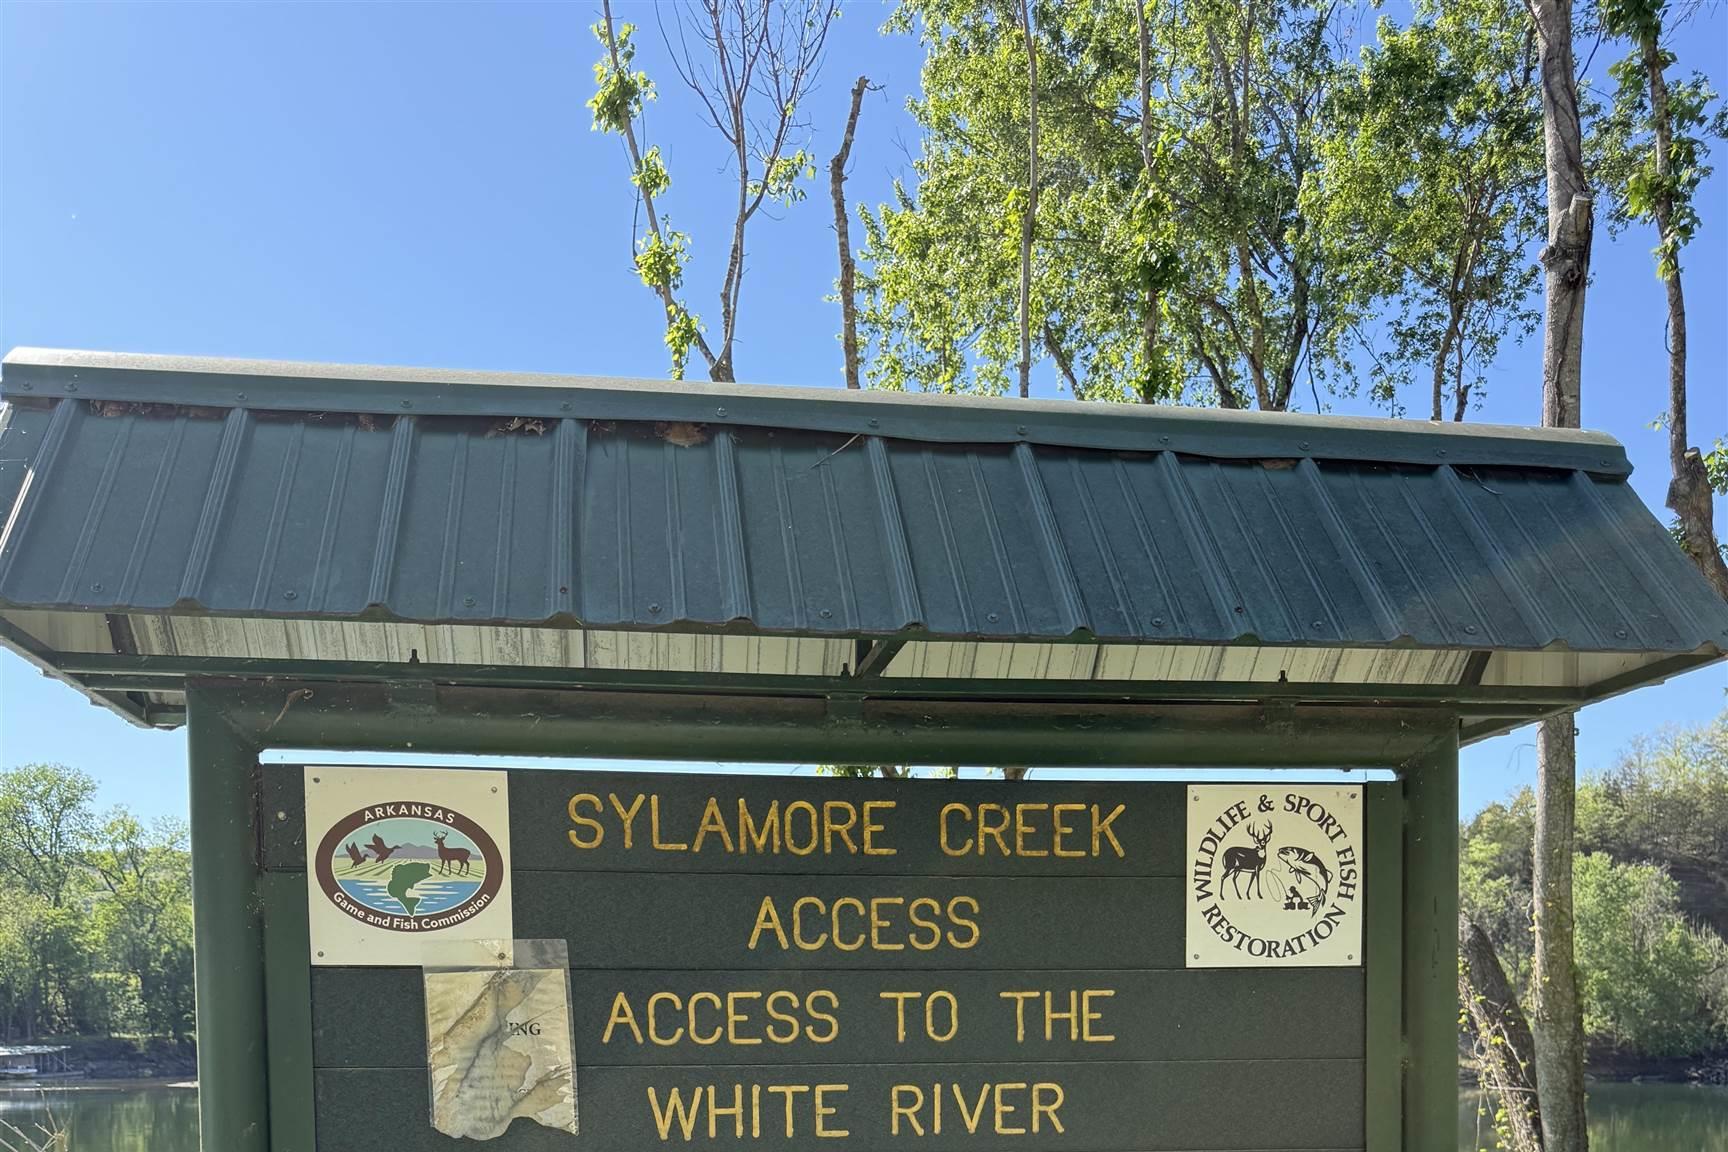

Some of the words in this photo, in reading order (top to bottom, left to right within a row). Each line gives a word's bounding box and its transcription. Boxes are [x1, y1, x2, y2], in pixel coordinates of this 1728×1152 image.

[363, 805, 456, 825] ARKANSAS
[568, 794, 896, 855] SYLAMORE
[941, 803, 1125, 857] CREEK
[1193, 801, 1252, 902] WILDLIFE
[1257, 794, 1275, 813] &
[1284, 793, 1348, 843] SPORT
[1336, 845, 1357, 901] FISH
[333, 891, 365, 919] Game
[366, 913, 390, 927] and
[393, 918, 418, 930] Fish
[421, 893, 491, 929] Commission
[748, 896, 980, 951] ACCESS
[1202, 902, 1346, 958] RESTORATION
[603, 990, 838, 1045] ACCESS
[880, 991, 958, 1041] TO
[1000, 990, 1115, 1042] THE
[647, 1084, 848, 1140] WHITE
[892, 1083, 1064, 1136] RIVER
